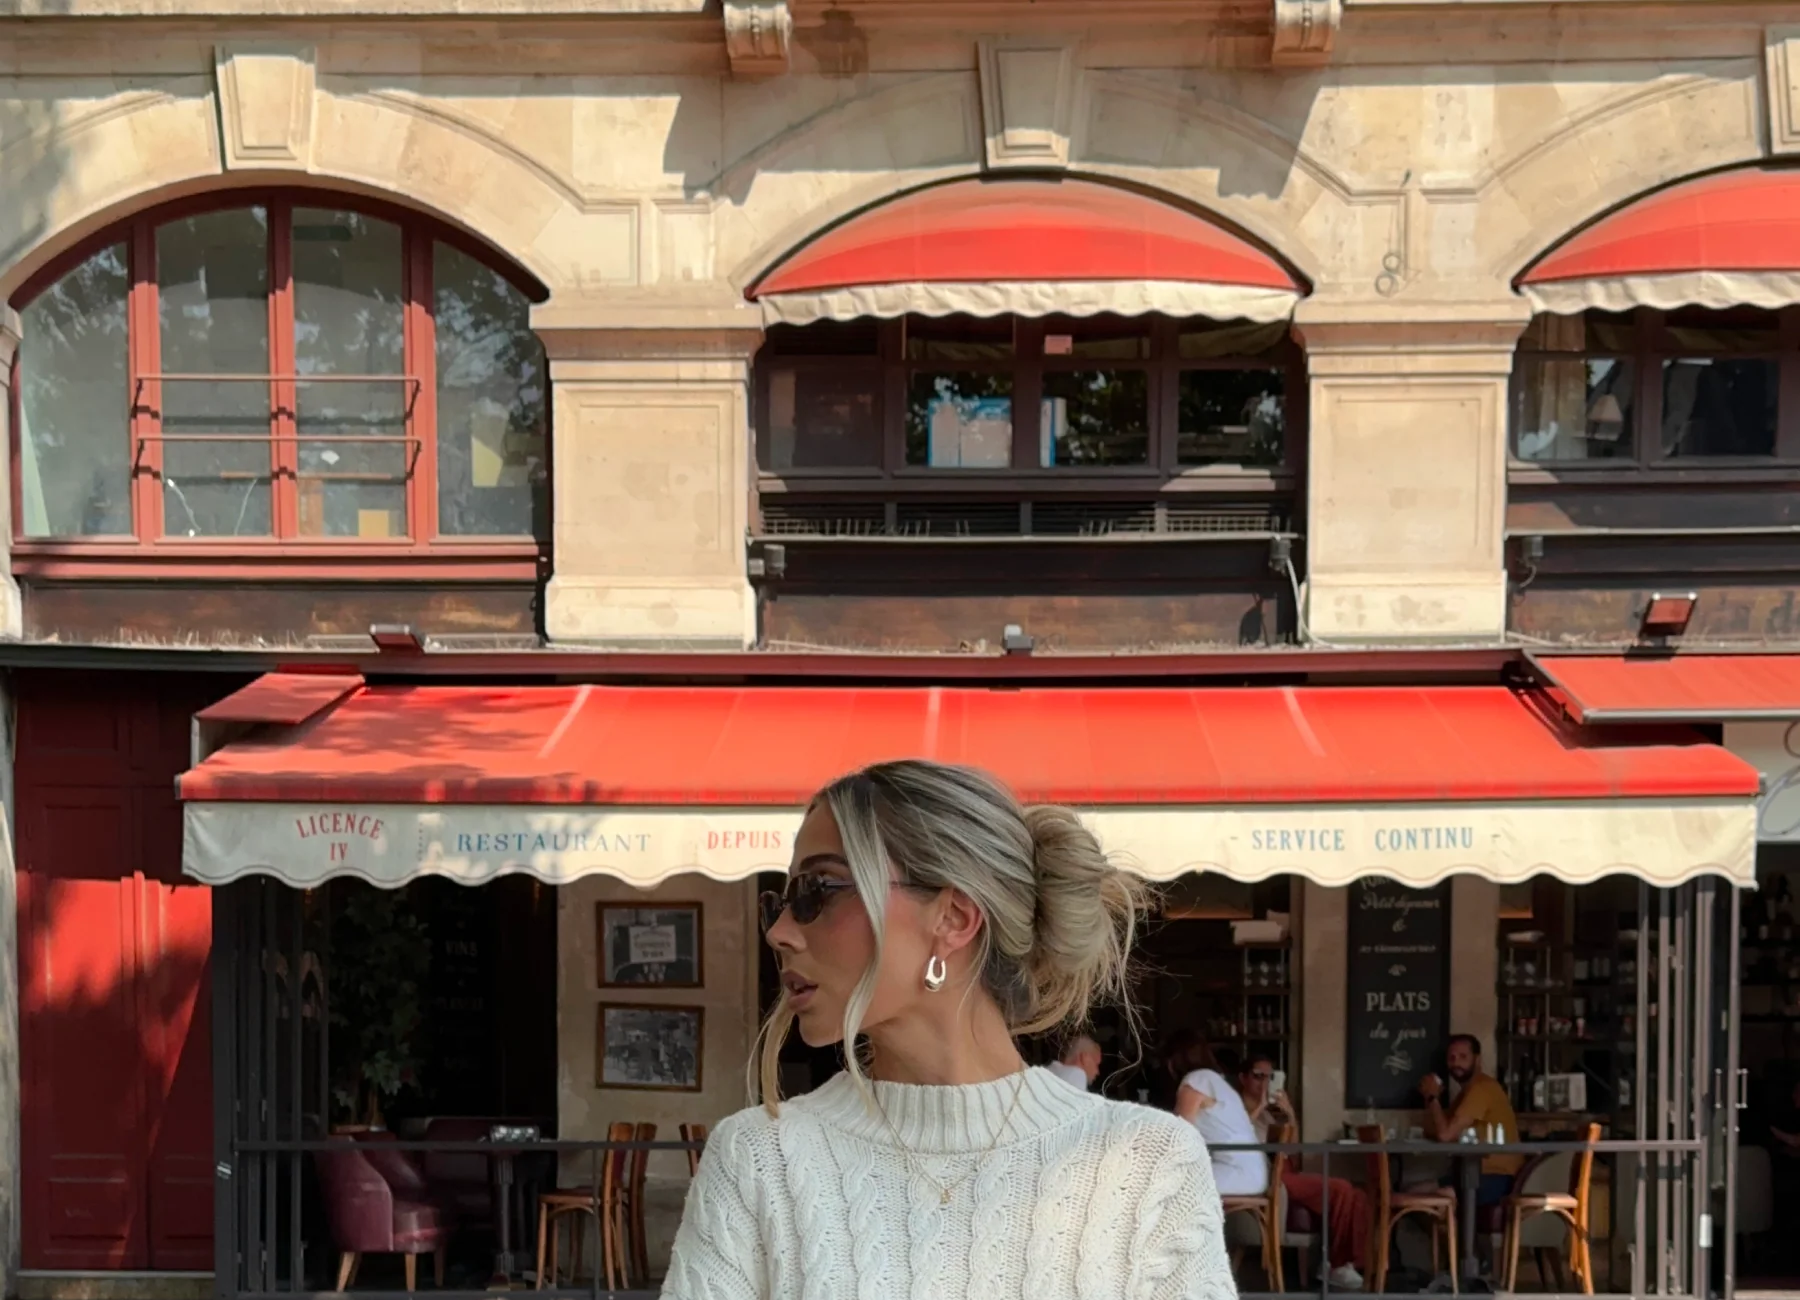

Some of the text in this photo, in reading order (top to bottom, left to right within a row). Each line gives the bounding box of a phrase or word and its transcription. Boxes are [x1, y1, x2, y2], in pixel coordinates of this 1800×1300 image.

[296, 812, 384, 840] LICENCE
[457, 833, 652, 852] RESTAURANT
[707, 830, 782, 850] DEPUIS
[1252, 827, 1474, 851] SERVICE CONTINU
[330, 842, 348, 861] IV
[1365, 991, 1431, 1012] PLATS
